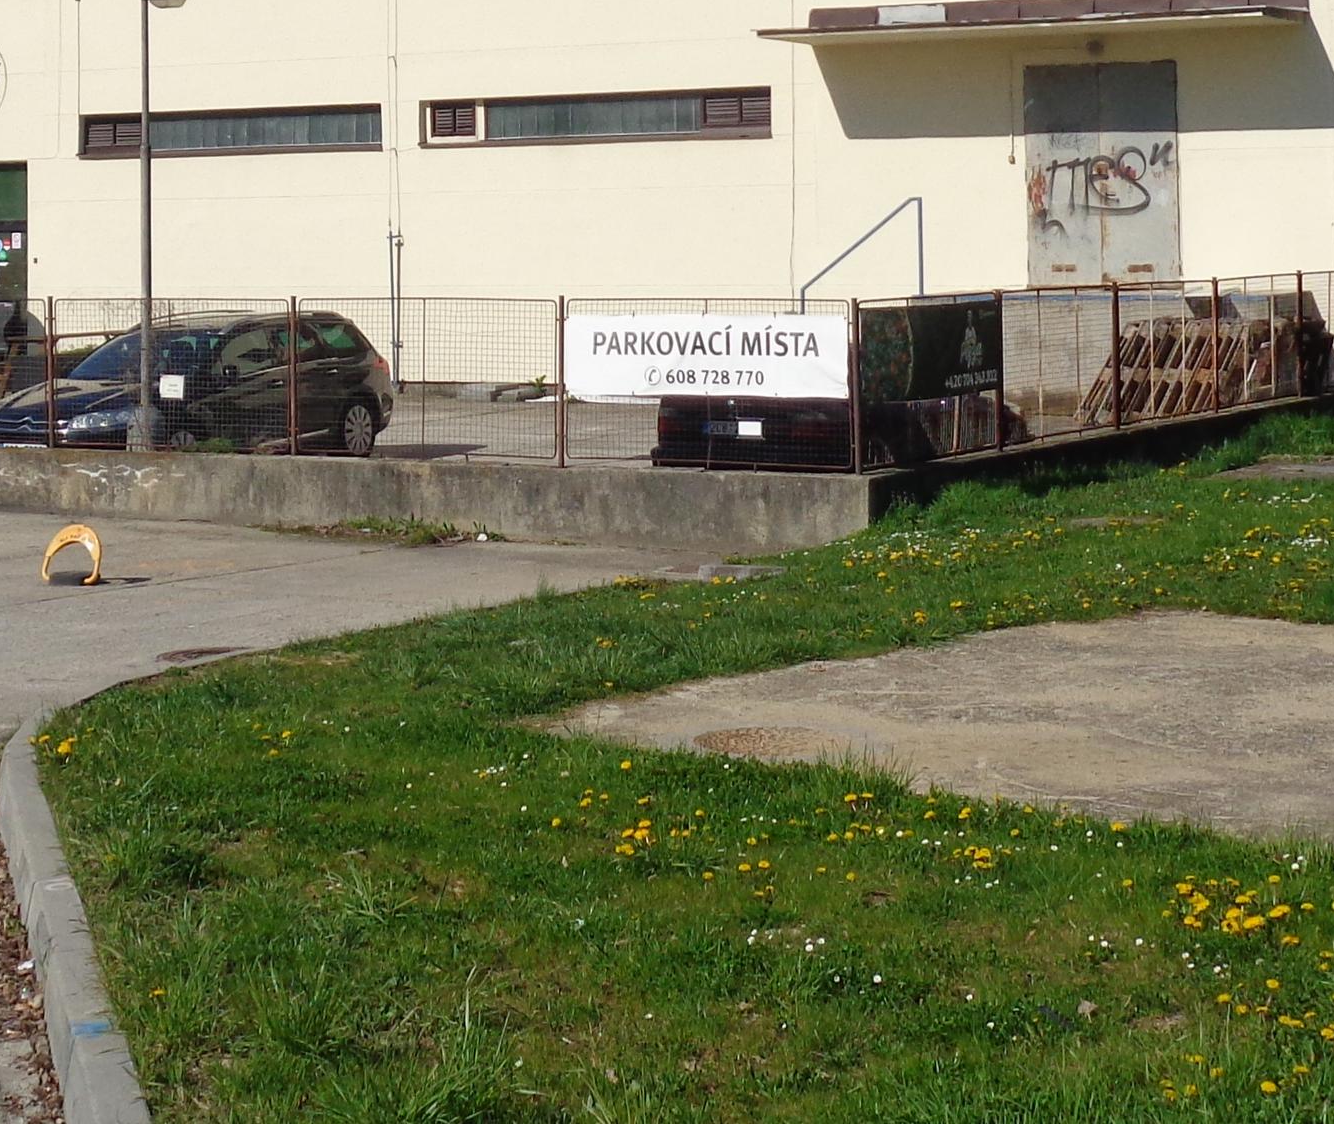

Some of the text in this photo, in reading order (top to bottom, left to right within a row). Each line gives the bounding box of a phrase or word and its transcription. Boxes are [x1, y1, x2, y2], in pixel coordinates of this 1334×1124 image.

[592, 324, 820, 357] PARKOVACÍ MÍSTA
[666, 369, 765, 386] 608 728 770
